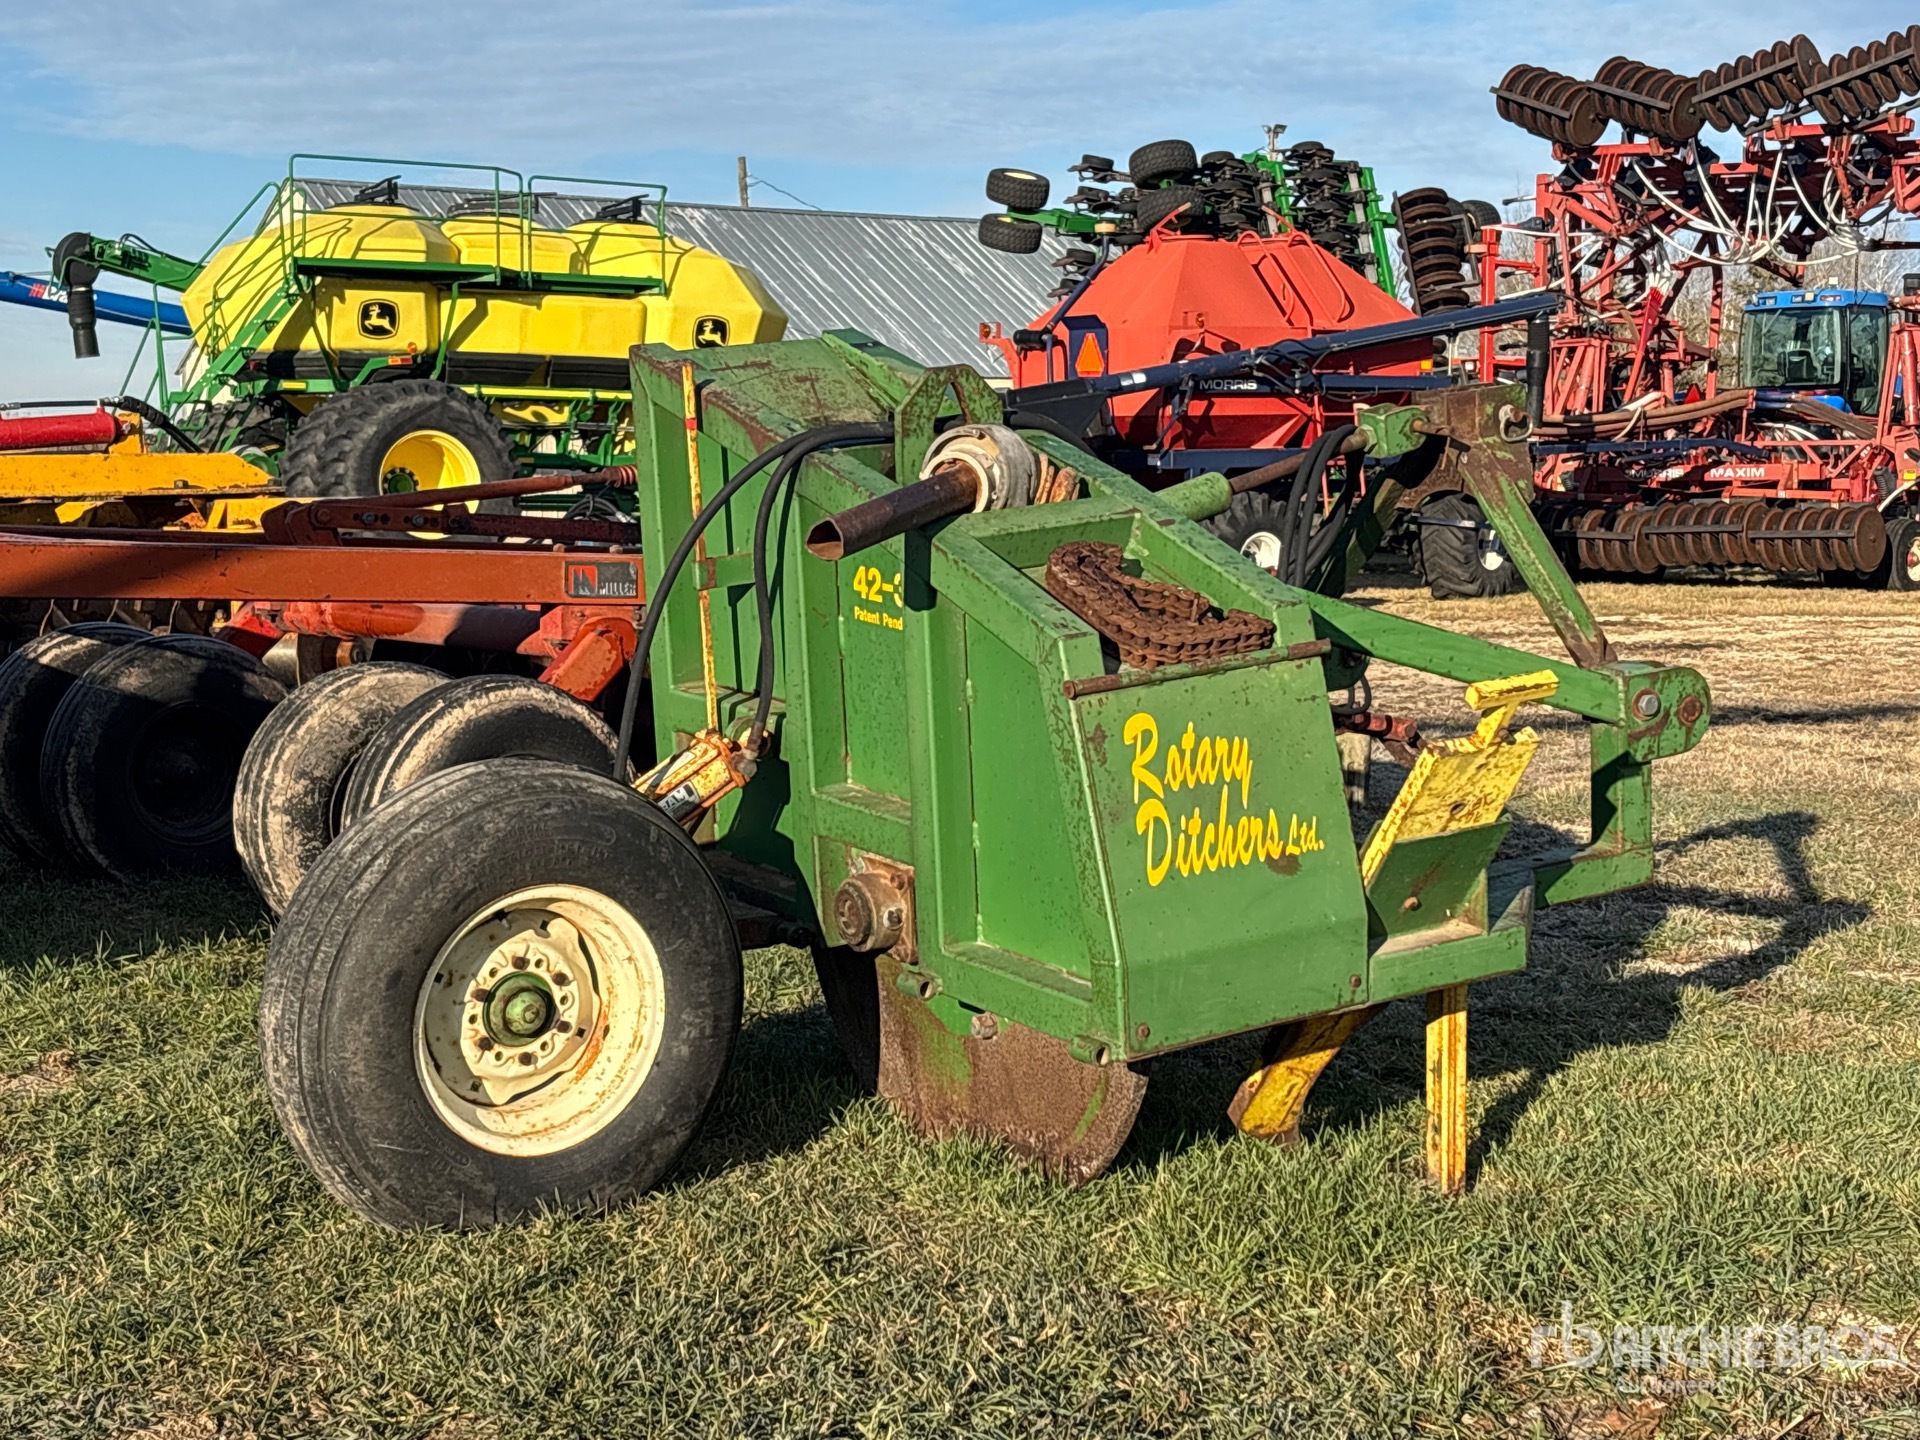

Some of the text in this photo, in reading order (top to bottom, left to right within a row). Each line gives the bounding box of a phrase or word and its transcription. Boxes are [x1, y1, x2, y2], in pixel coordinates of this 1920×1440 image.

[1200, 379, 1258, 390] MORRIS
[1710, 467, 1765, 478] MAXIM
[854, 605, 904, 630] Patent Pend
[1123, 712, 1253, 809] Rotary
[1136, 784, 1325, 887] Ditchers Ltd.
